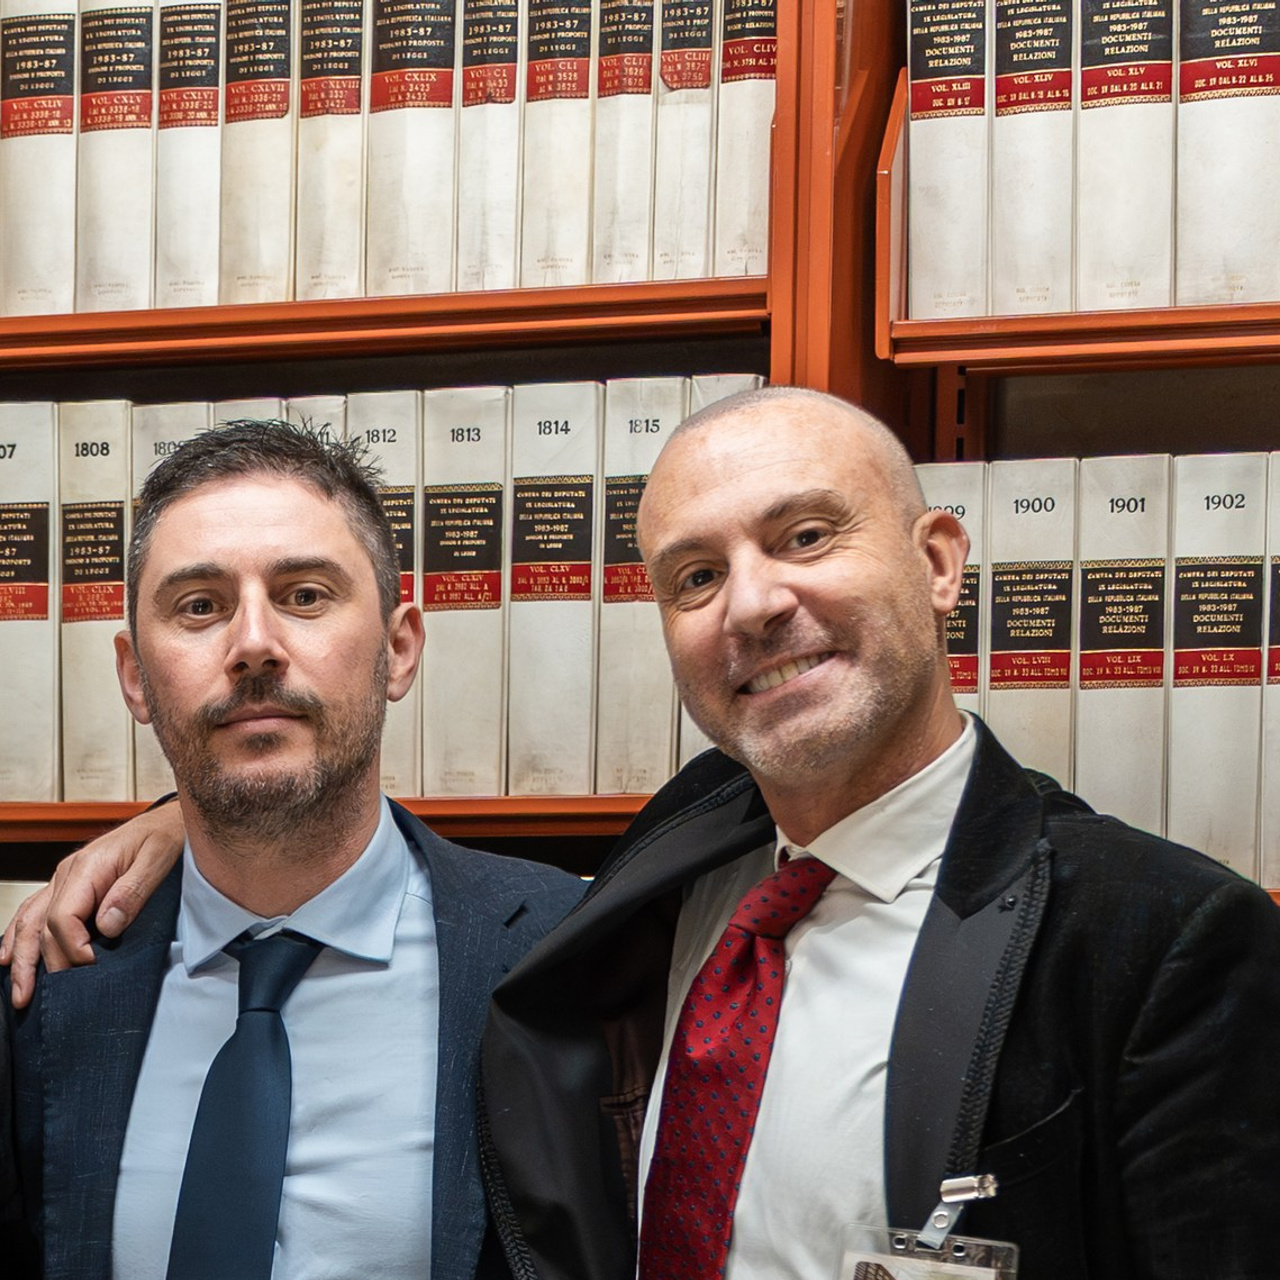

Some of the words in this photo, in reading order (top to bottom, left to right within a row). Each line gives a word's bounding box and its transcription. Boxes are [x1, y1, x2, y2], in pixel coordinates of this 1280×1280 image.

[664, 7, 709, 18] 1983-87
[1017, 5, 1061, 14] LEGISLATURA
[604, 13, 647, 24] 1983-87
[933, 12, 976, 21] LEGISLATURA
[469, 24, 512, 35] 1983-87
[535, 20, 578, 30] 1983-87
[389, 27, 432, 38] 1983-87
[1211, 26, 1262, 37] DOCUMENTI
[310, 39, 353, 49] 1983-87
[1101, 33, 1152, 44] DOCUMENTI
[1214, 38, 1260, 48] RELAZIONI
[234, 42, 274, 54] 1983-87
[1010, 39, 1060, 50] DOCUMENTI
[1105, 45, 1149, 55] RELAZIONI
[167, 49, 210, 59] 1983-87
[925, 45, 974, 57] DOCUMENTI
[1013, 51, 1056, 62] RELAZIONI
[92, 53, 135, 64] 1983-87
[928, 57, 971, 68] RELAZIONI
[1216, 61, 1235, 69] VOL.
[1238, 59, 1258, 67] XLVI
[16, 59, 58, 70] 1983-87
[558, 61, 577, 70] CLI
[404, 73, 437, 82] CXLIX
[1107, 69, 1125, 77] VOL.
[1128, 67, 1146, 76] XLV
[1013, 76, 1031, 85] VOL.
[1034, 74, 1053, 82] XLIV
[931, 84, 949, 92] VOL.
[537, 420, 571, 435] 1814
[629, 419, 660, 434] 1815
[365, 429, 397, 444] 1812
[450, 428, 481, 443] 1813
[74, 442, 110, 458] 1808
[1013, 497, 1056, 514] 1900
[1108, 497, 1146, 513] 1901
[1204, 493, 1246, 510] 1902
[1099, 615, 1148, 623] DOCUMENTI
[1193, 614, 1243, 622] DOCUMENTI
[1010, 629, 1052, 637] RELAZIONI
[1197, 625, 1241, 633] RELAZIONI
